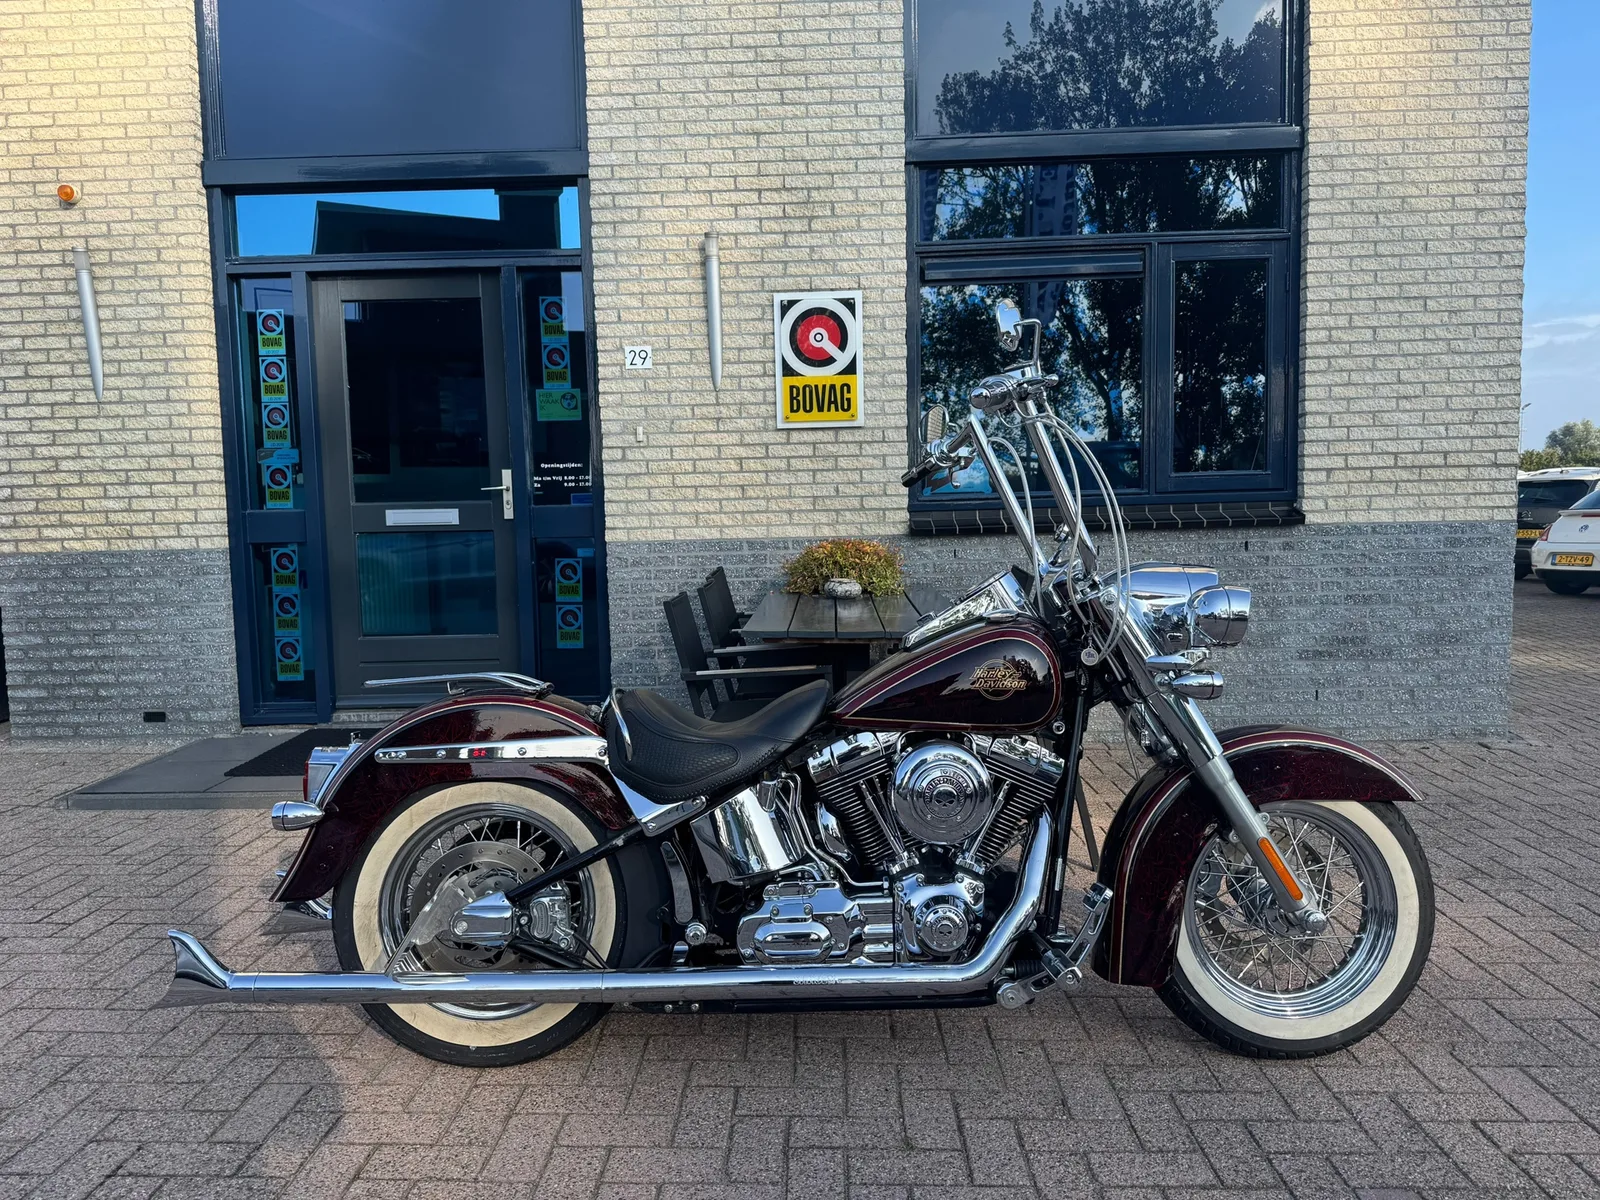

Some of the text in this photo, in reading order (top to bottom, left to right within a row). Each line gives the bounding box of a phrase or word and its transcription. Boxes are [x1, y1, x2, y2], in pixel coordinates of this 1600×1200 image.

[544, 324, 565, 335] BOVAG
[262, 337, 283, 348] BOVAG
[628, 349, 649, 366] 29
[546, 371, 567, 381] BOVAG
[264, 384, 285, 394] BOVAG
[789, 382, 852, 414] BOVAG
[267, 430, 288, 440] BOVAG
[269, 490, 290, 501] BOVAG
[1558, 555, 1590, 564] 2-TZV-49
[275, 574, 296, 585] BOVAG
[559, 585, 579, 595] BOVAG
[277, 618, 298, 629] BOVAG
[560, 631, 580, 641] BOVAG
[280, 663, 300, 674] BOVAG
[975, 678, 1026, 689] Davidson
